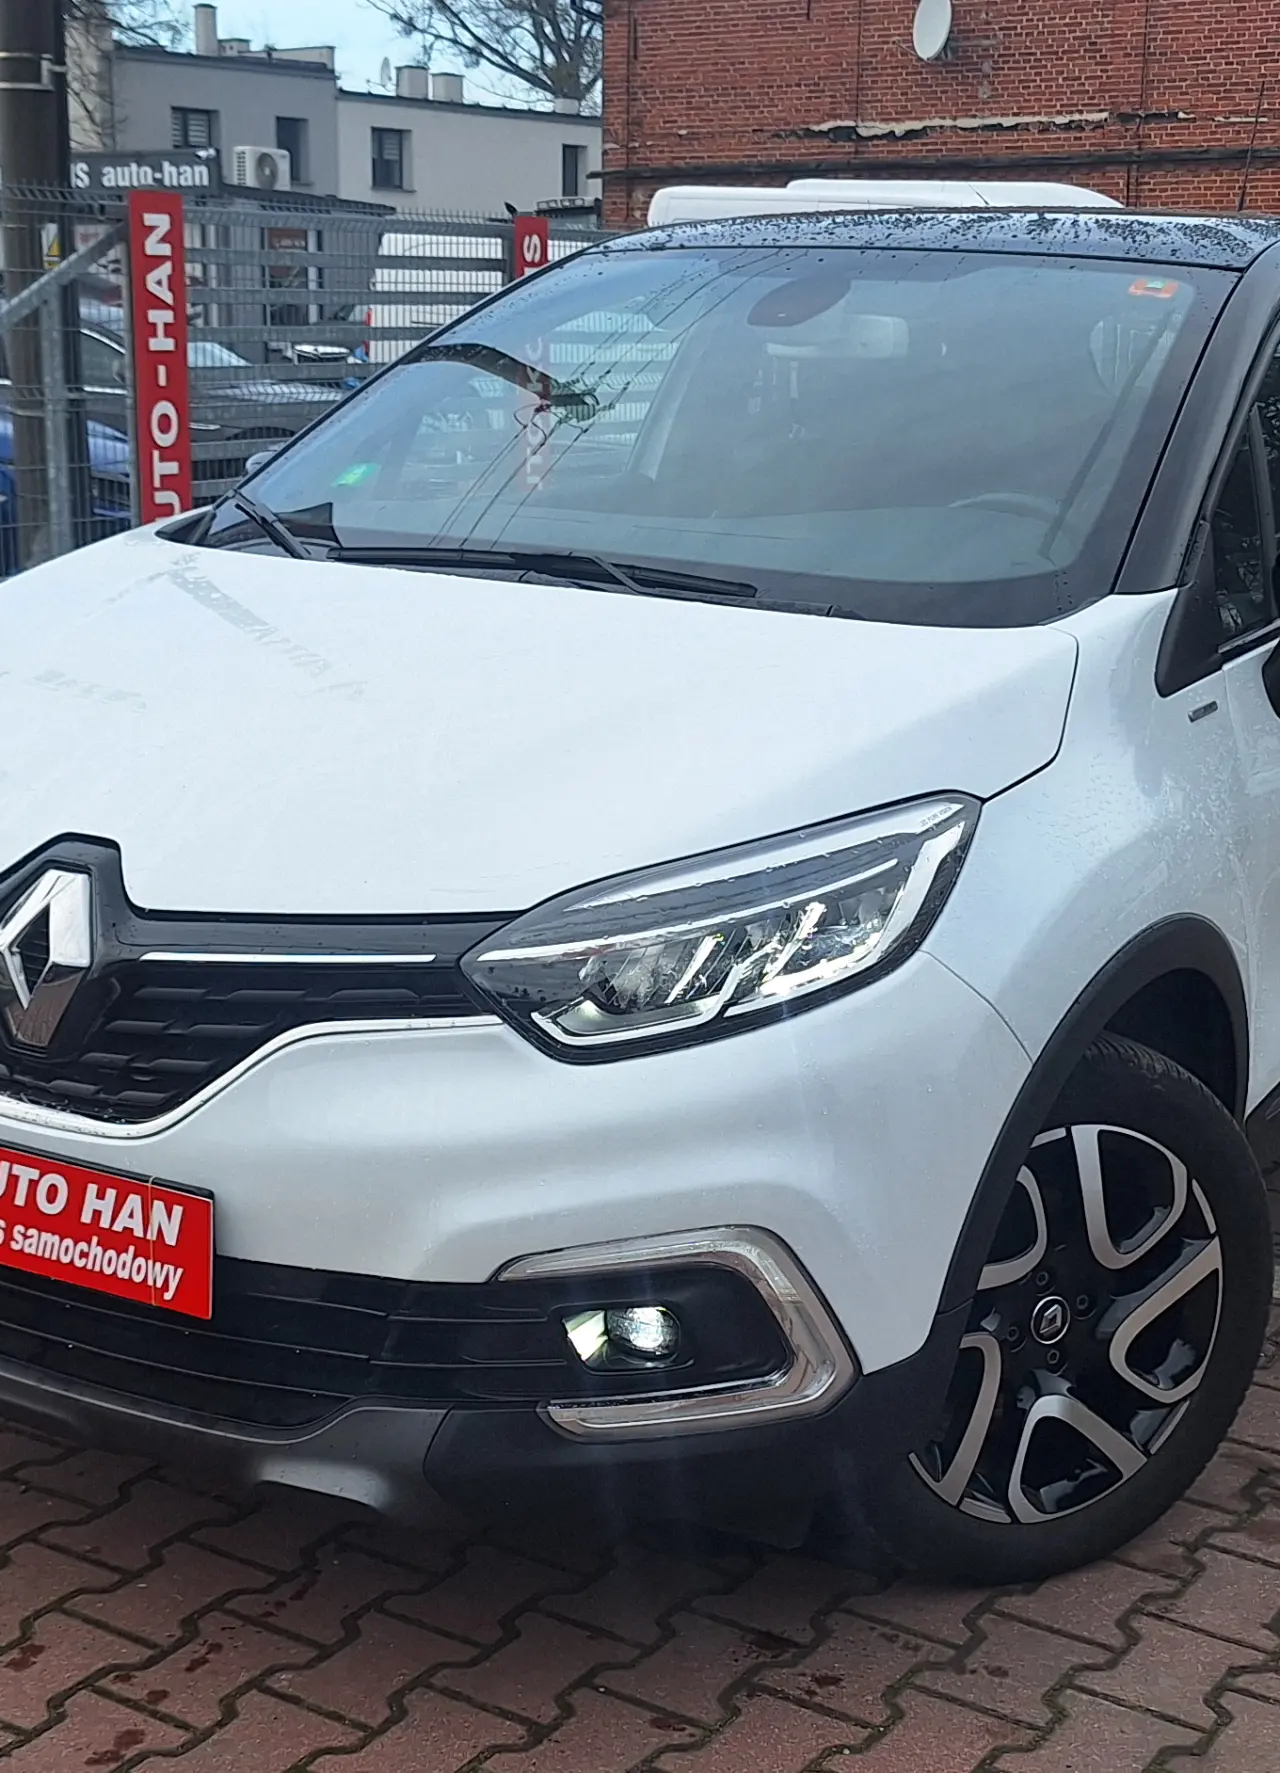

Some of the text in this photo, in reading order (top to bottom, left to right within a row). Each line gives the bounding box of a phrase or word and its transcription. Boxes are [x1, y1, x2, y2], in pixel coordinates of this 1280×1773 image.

[102, 161, 210, 188] auto-han
[143, 212, 182, 522] UTO-HAN
[80, 1183, 184, 1247] HAN
[10, 1224, 184, 1301] samochodowy
